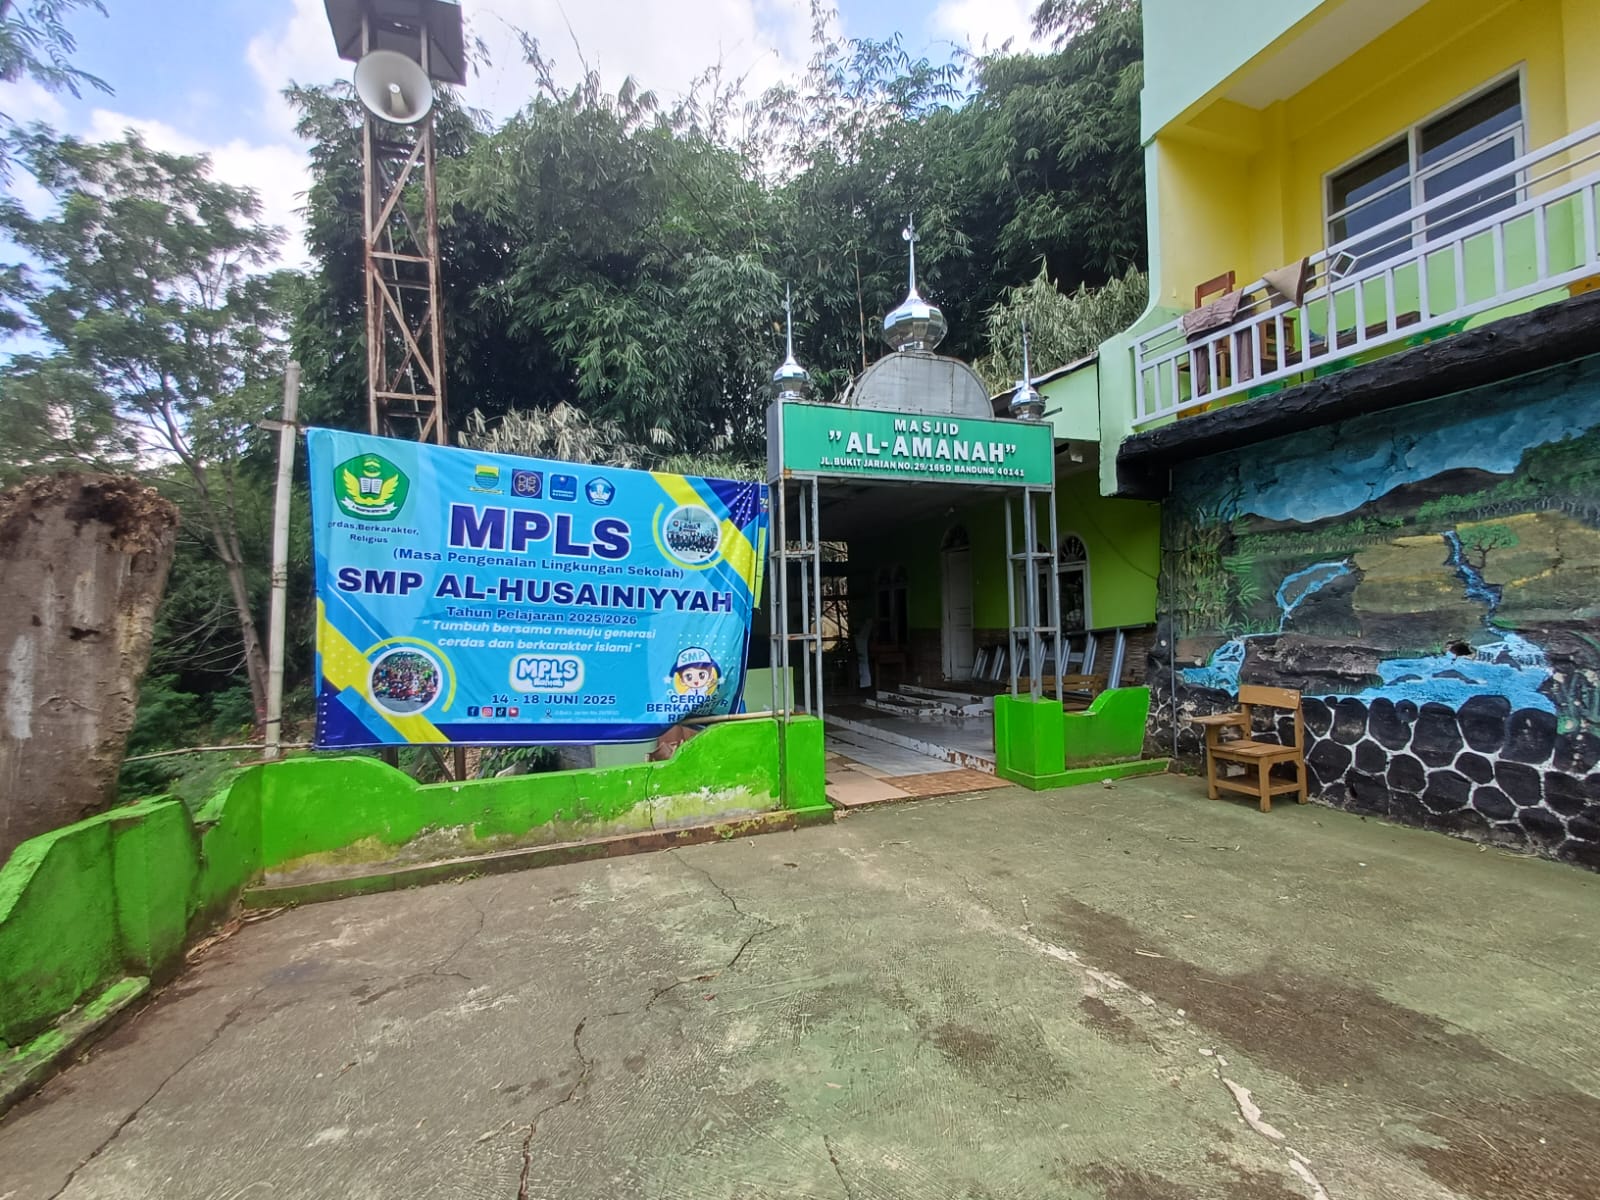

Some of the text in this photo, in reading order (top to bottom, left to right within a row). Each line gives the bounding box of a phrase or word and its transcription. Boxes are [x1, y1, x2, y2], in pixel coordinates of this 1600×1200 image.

[894, 418, 959, 436] MASJID
[863, 459, 896, 469] JARIAN
[954, 464, 995, 475] BANDUNG
[997, 467, 1025, 477] 40141
[350, 533, 389, 545] Religius
[450, 503, 631, 560] MPLS
[393, 548, 684, 580] (Masa Pengenalan Lingkungan Sekolah)
[338, 567, 733, 613] SMP AL-HUSAINIYYAH
[446, 606, 637, 625] Tahun Pelajaran 2025/2026
[492, 623, 552, 635] bersama
[554, 626, 602, 639] menuju
[604, 629, 657, 640] generasi
[438, 637, 485, 648] cerdas
[488, 638, 514, 649] dan
[517, 639, 594, 652] berkarakter
[681, 652, 706, 663] SMP
[516, 658, 578, 681] MPLS
[492, 694, 509, 704] 14
[523, 694, 540, 704] 18
[544, 694, 579, 705] JUNI
[583, 695, 616, 705] 2025
